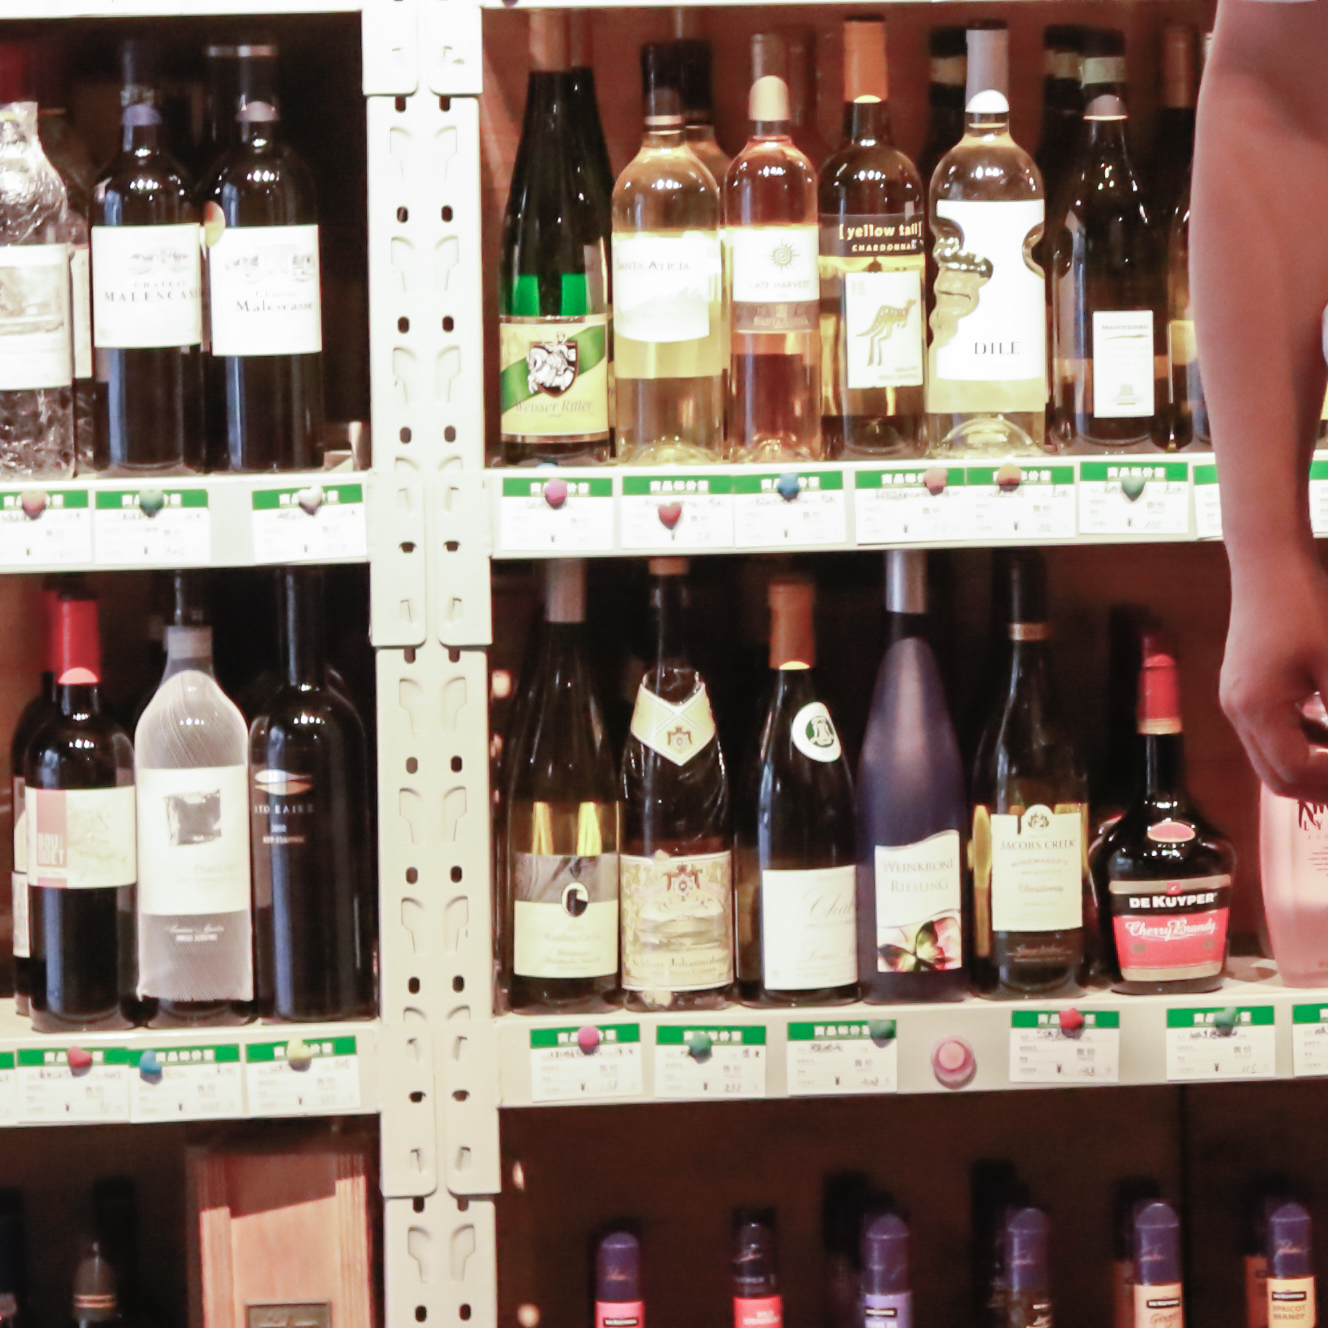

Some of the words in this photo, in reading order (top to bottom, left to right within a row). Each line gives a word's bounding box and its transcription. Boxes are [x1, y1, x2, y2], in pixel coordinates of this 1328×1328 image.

[974, 341, 1021, 354] DILE
[891, 880, 948, 892] RIESLING
[1129, 897, 1147, 909] DE
[1148, 894, 1214, 909] KUYPER
[1125, 919, 1172, 942] Cherry
[1172, 916, 1217, 940] Brandy
